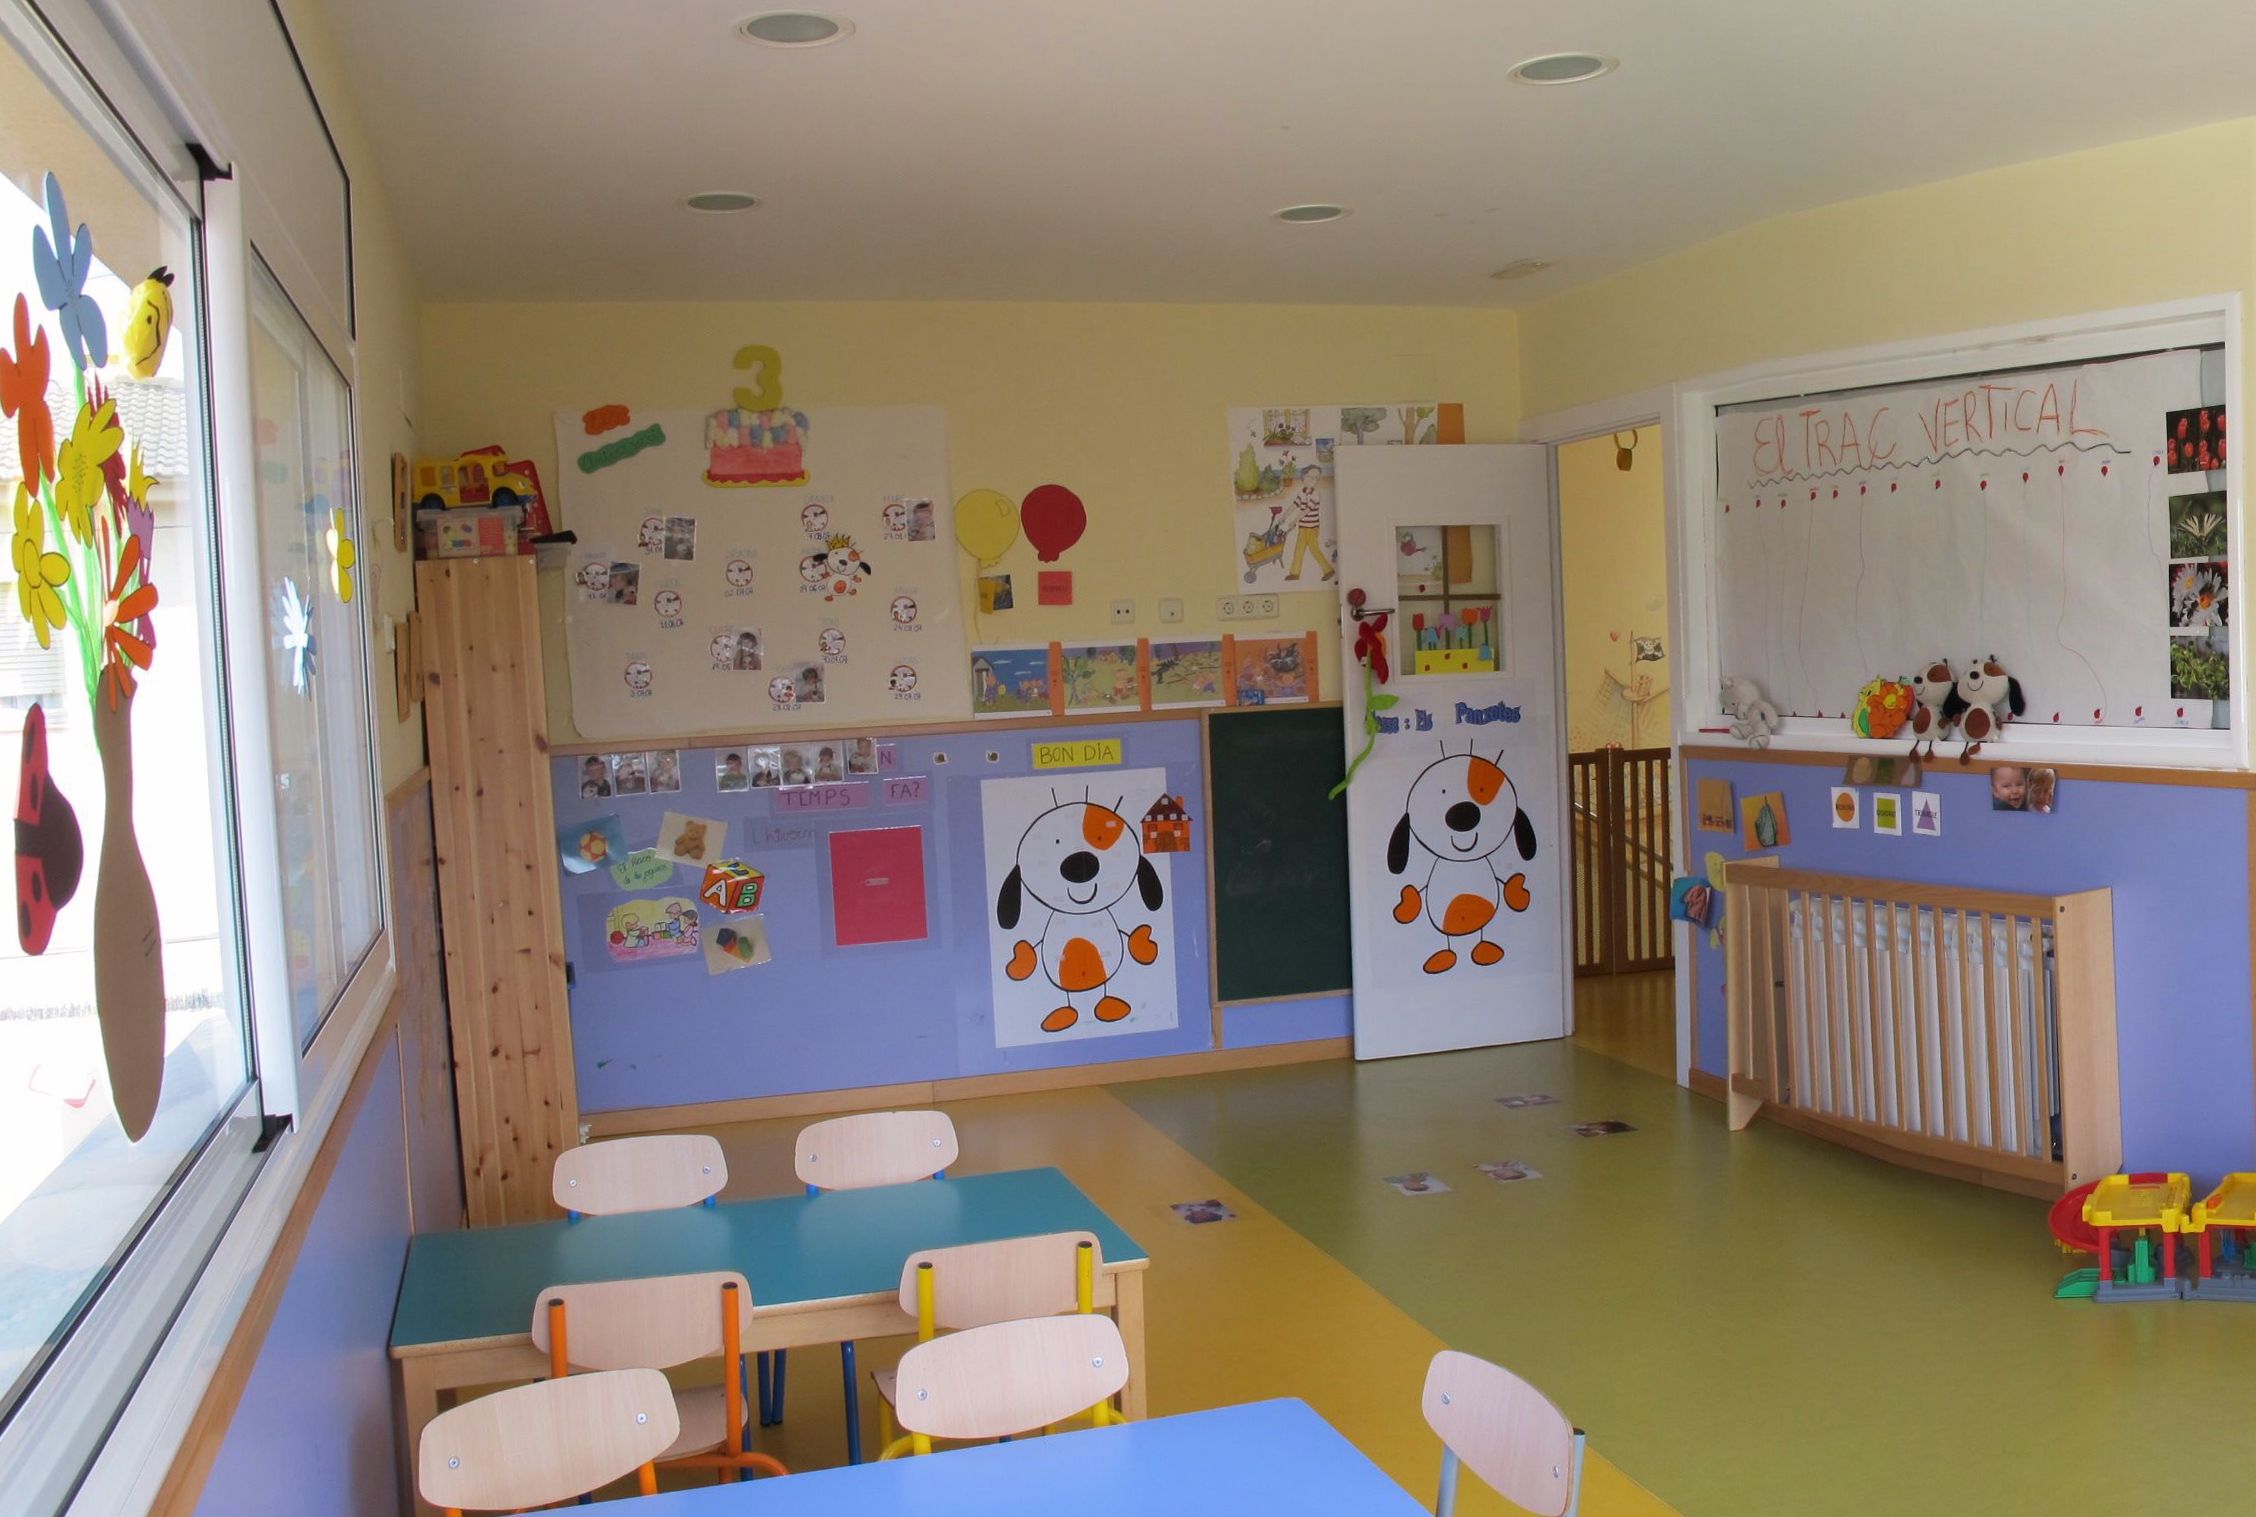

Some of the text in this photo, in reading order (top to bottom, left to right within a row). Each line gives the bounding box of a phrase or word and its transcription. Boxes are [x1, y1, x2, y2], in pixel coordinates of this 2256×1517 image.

[733, 345, 783, 411] 3
[1918, 377, 2109, 454] VERTICAL
[1039, 745, 1075, 765] BON
[780, 781, 921, 808] TEMPS FA?
[702, 878, 728, 908] A
[735, 881, 760, 908] B
